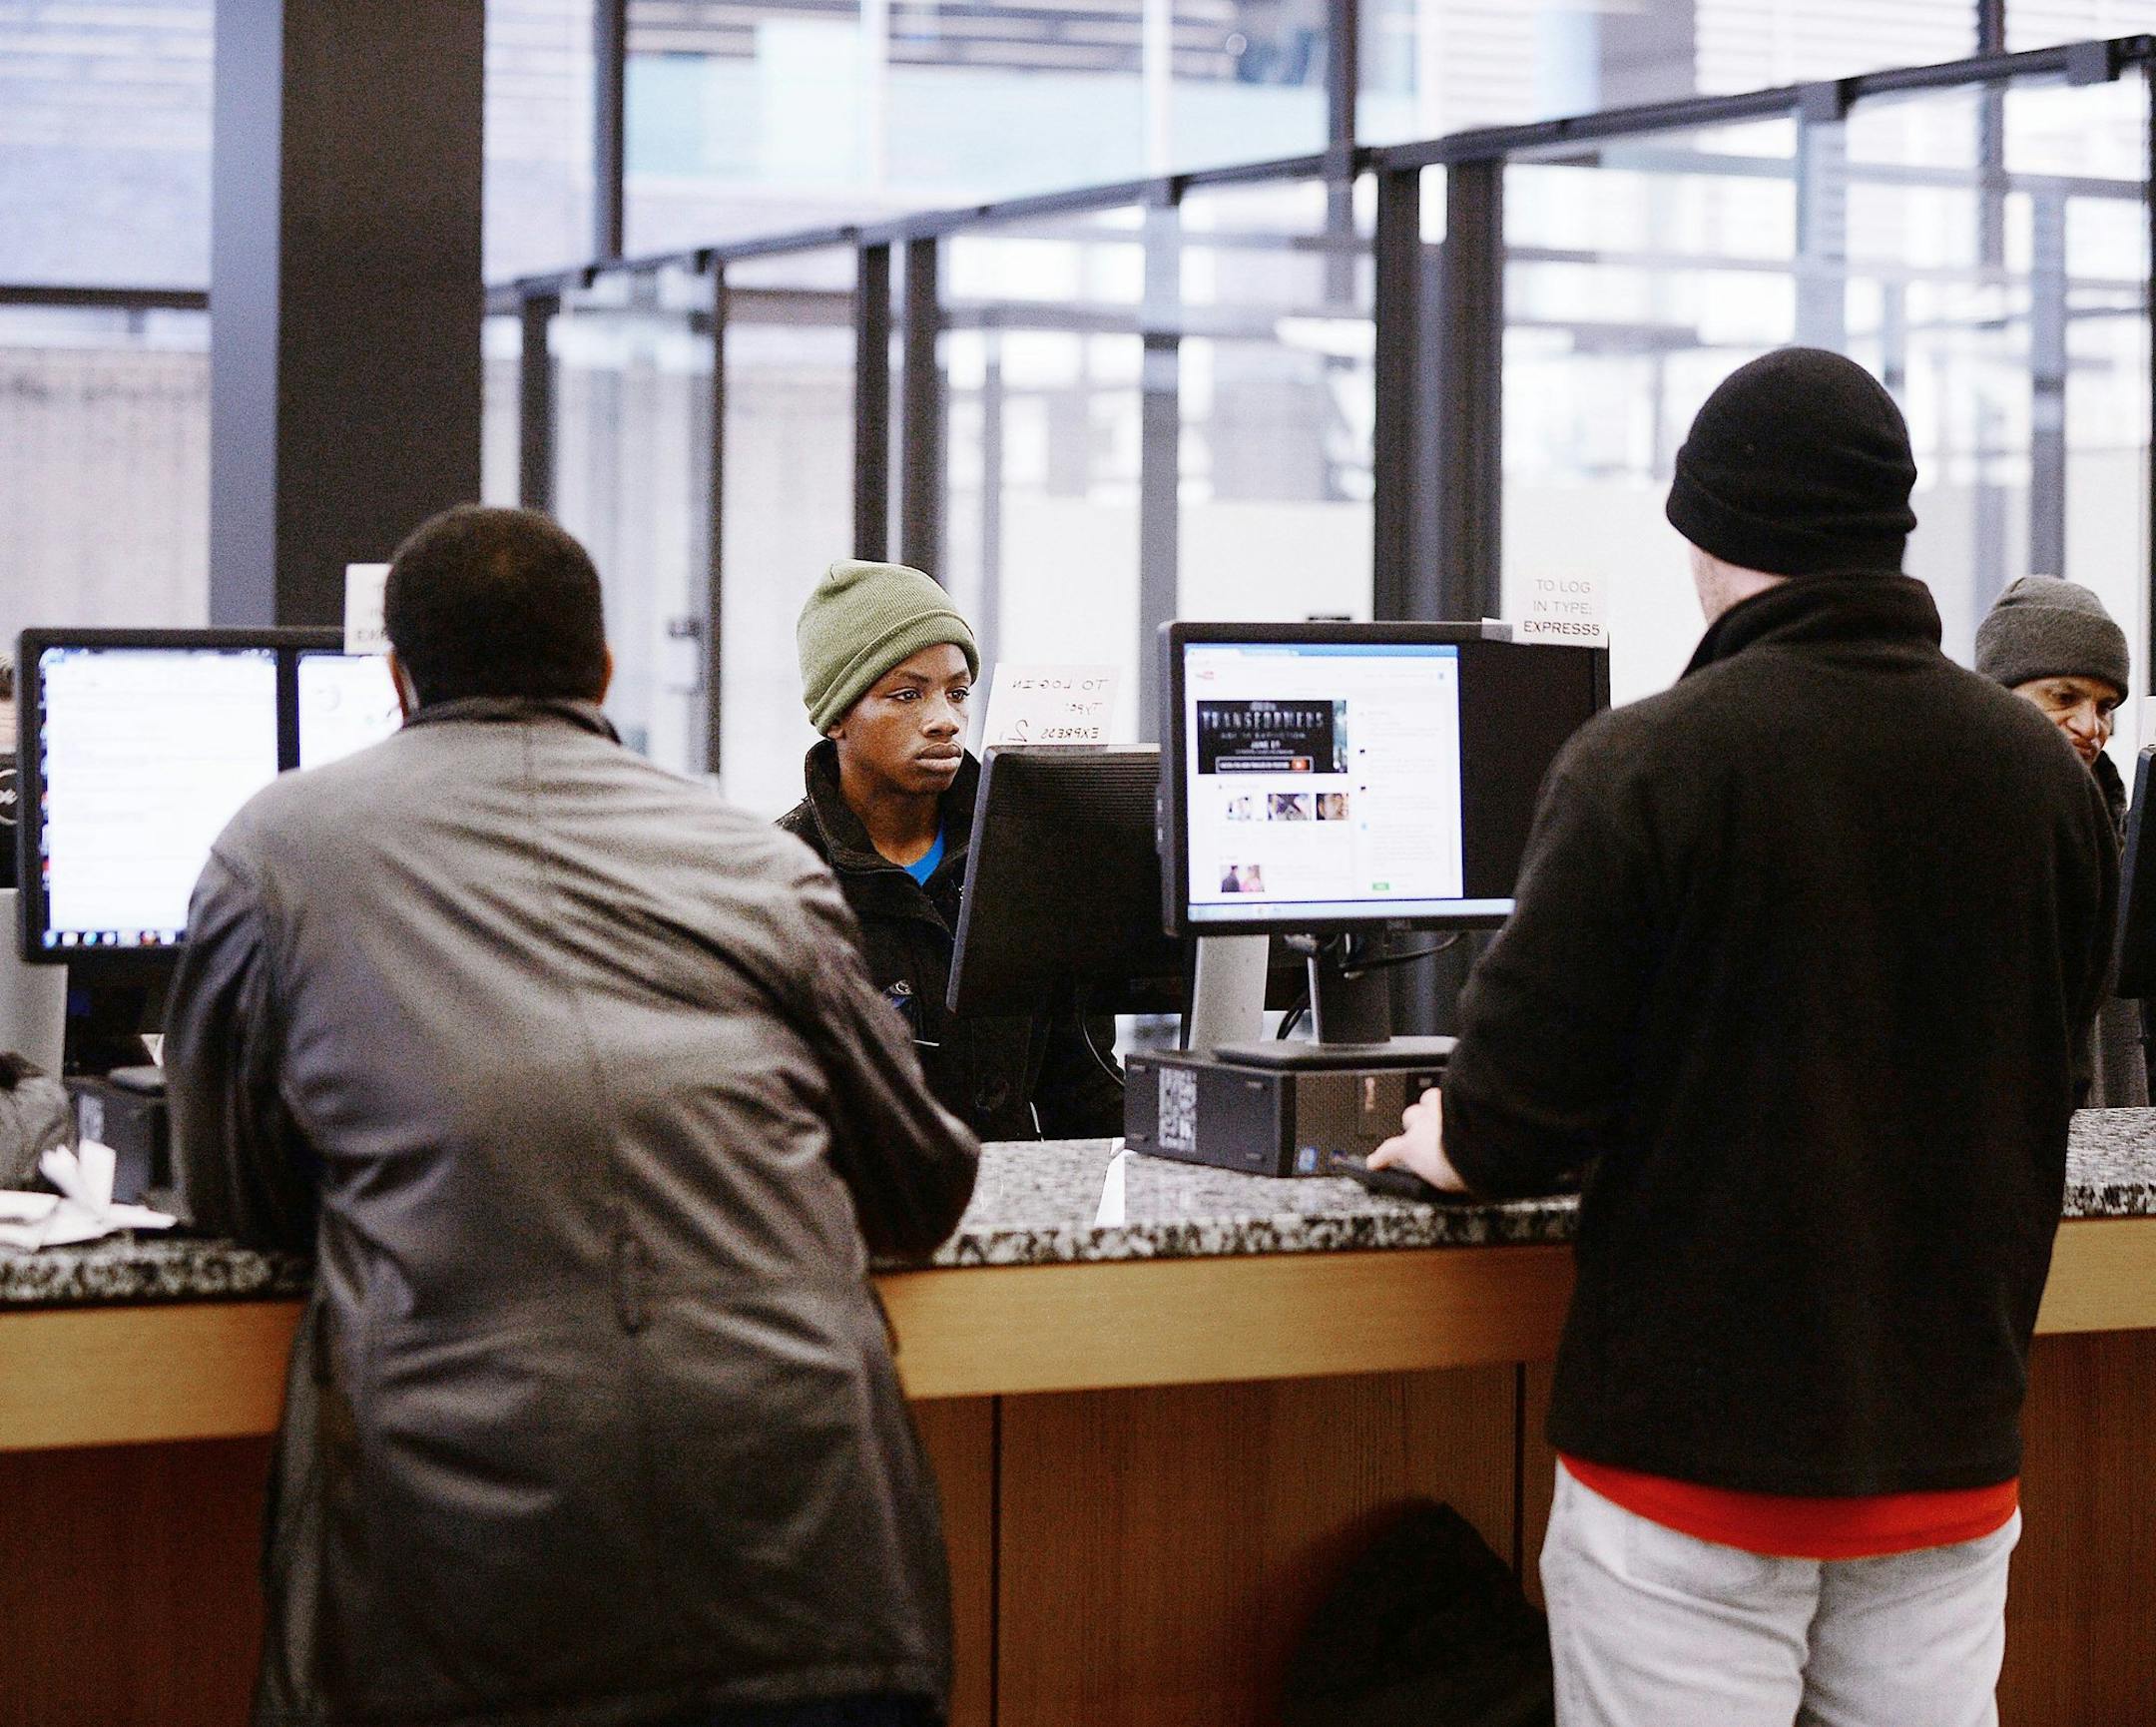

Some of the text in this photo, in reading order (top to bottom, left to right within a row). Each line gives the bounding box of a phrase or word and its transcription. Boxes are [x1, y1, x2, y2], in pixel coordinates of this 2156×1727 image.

[1536, 579, 1591, 594] TO LOG
[1533, 600, 1593, 615] IN TYPE:
[1523, 620, 1601, 637] EXPRESS5
